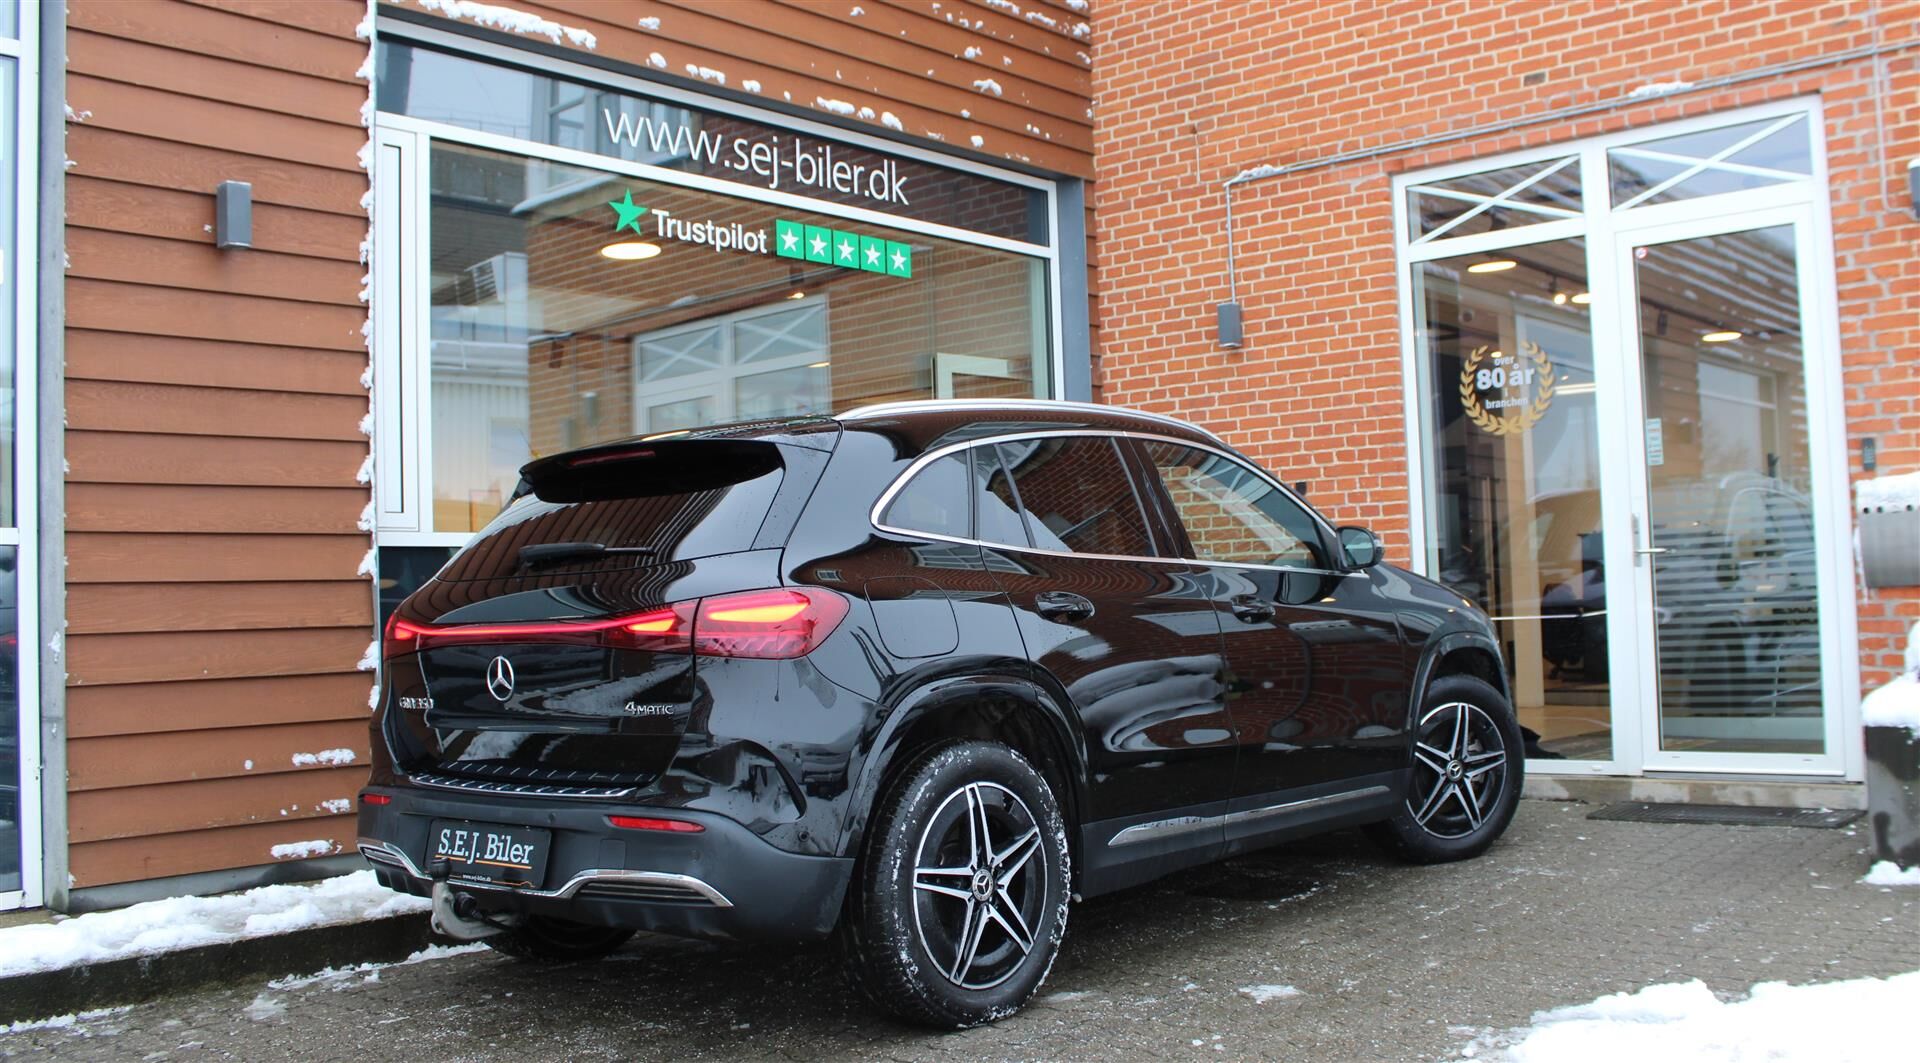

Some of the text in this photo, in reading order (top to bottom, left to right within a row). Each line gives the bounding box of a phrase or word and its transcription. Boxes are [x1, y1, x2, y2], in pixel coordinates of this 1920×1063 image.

[604, 108, 909, 206] www.sej-biler.dk
[651, 208, 767, 254] Trustpilot
[1476, 363, 1535, 390] 80 år
[1485, 397, 1529, 410] branchen
[624, 701, 674, 715] 4MATIC
[438, 828, 534, 865] S.E.J. Biler
